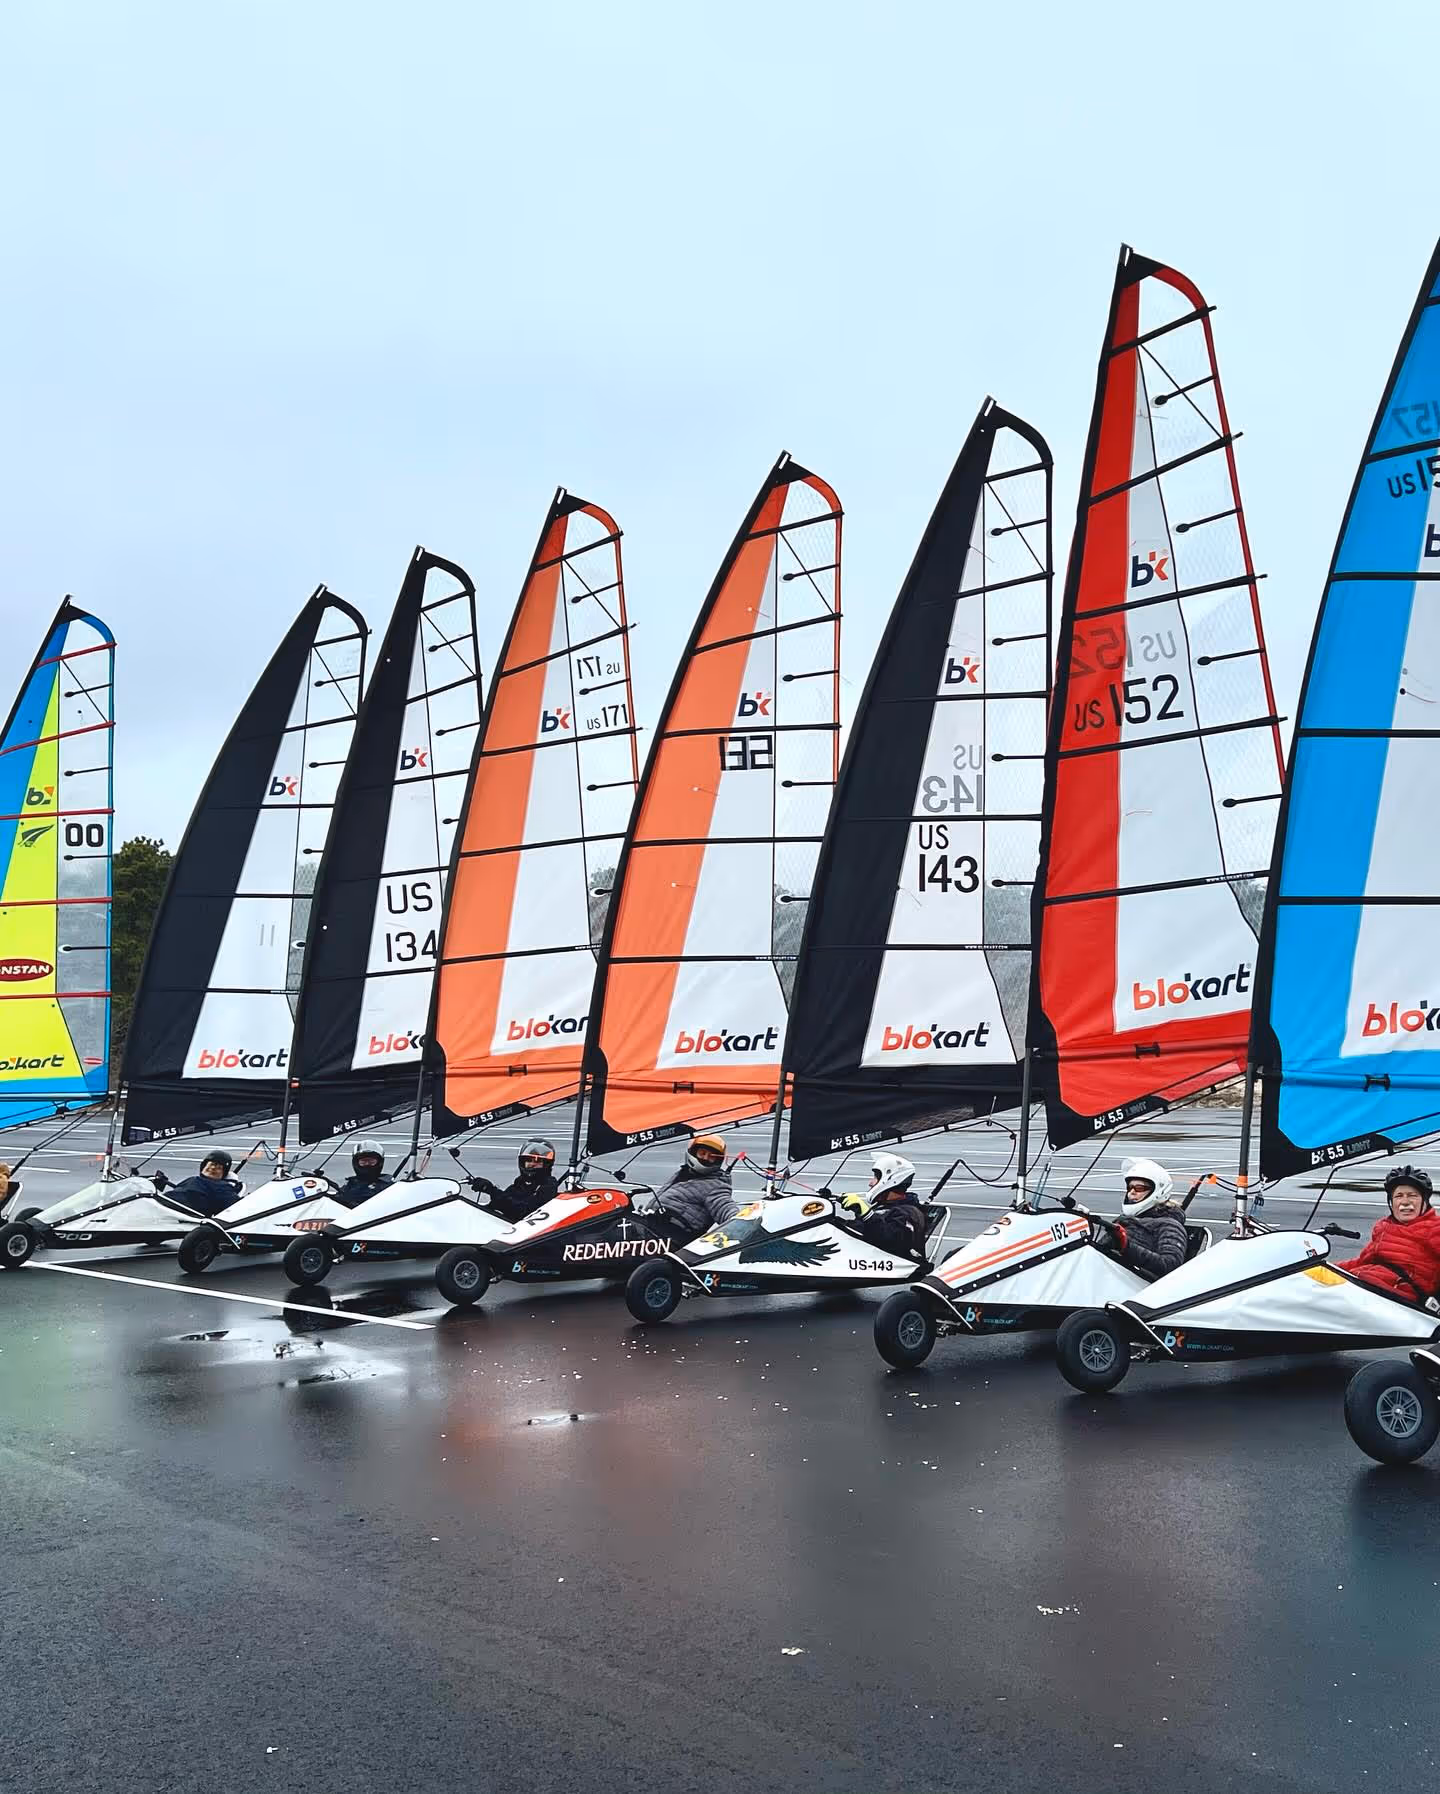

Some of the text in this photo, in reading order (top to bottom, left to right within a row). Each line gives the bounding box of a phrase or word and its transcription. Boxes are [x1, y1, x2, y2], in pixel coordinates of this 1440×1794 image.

[1388, 472, 1416, 498] US
[1073, 673, 1184, 732] US 152
[586, 703, 629, 730] US 171
[919, 824, 949, 850] US
[919, 853, 980, 893] 143
[386, 882, 433, 914] US
[385, 929, 438, 963] 134
[0, 965, 50, 975] NSTAN
[1133, 963, 1251, 1011] blokart
[1362, 1000, 1440, 1037] blok
[674, 1027, 778, 1054] blokart
[881, 1021, 990, 1051] blokart
[197, 1049, 289, 1069] blokart
[344, 1119, 357, 1130] 5.5
[480, 1112, 494, 1122] 5.5
[1108, 1108, 1124, 1123] 5.5
[164, 1127, 177, 1137] 5.5
[639, 1130, 654, 1142] 5.5
[844, 1134, 860, 1146] 5.5
[1326, 1144, 1345, 1160] 5.5
[1050, 1222, 1069, 1241] 152
[562, 1238, 672, 1262] REDEMPTION
[848, 1259, 894, 1272] US-143
